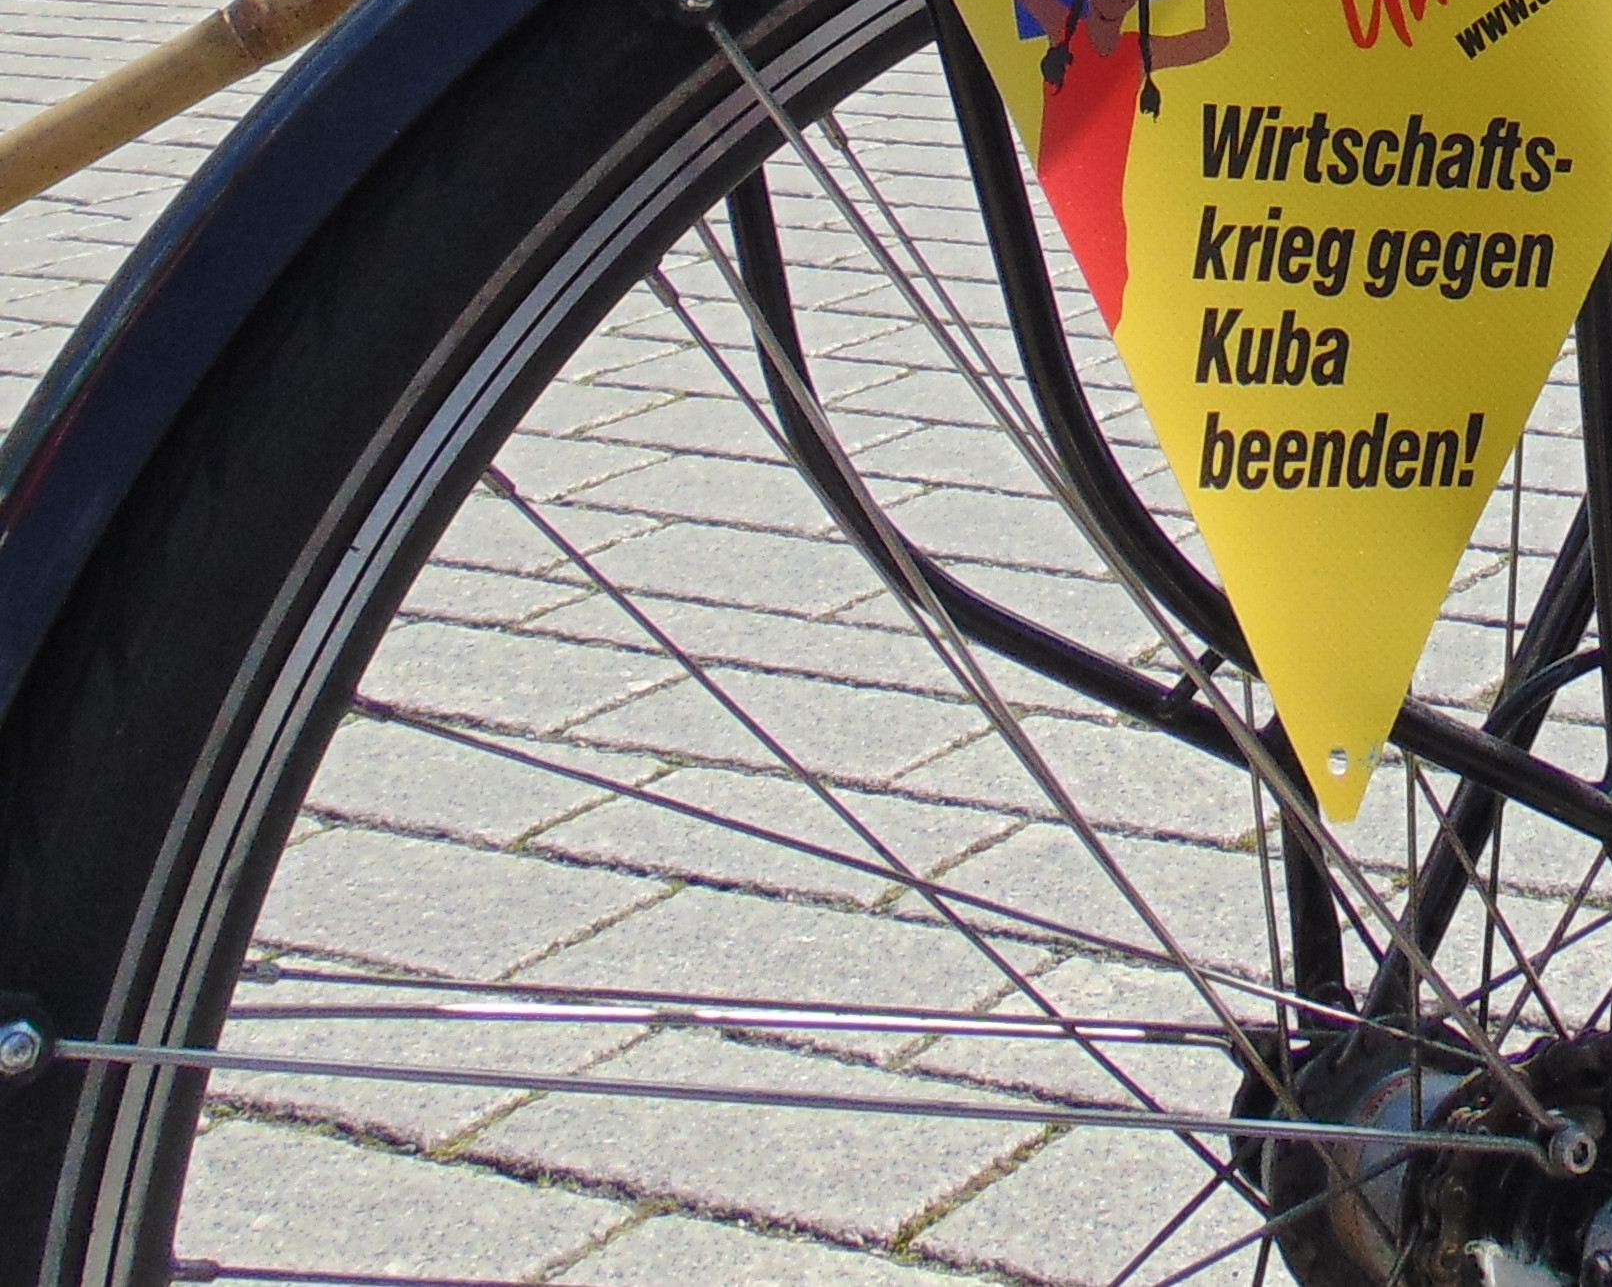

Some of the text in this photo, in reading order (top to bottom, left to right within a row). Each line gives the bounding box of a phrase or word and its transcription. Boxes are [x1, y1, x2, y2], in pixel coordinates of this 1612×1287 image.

[1202, 103, 1573, 193] Wirtschafts-
[1193, 205, 1554, 300] krieg gegen
[1195, 307, 1351, 387] Kuba
[1199, 412, 1486, 491] beenden!
